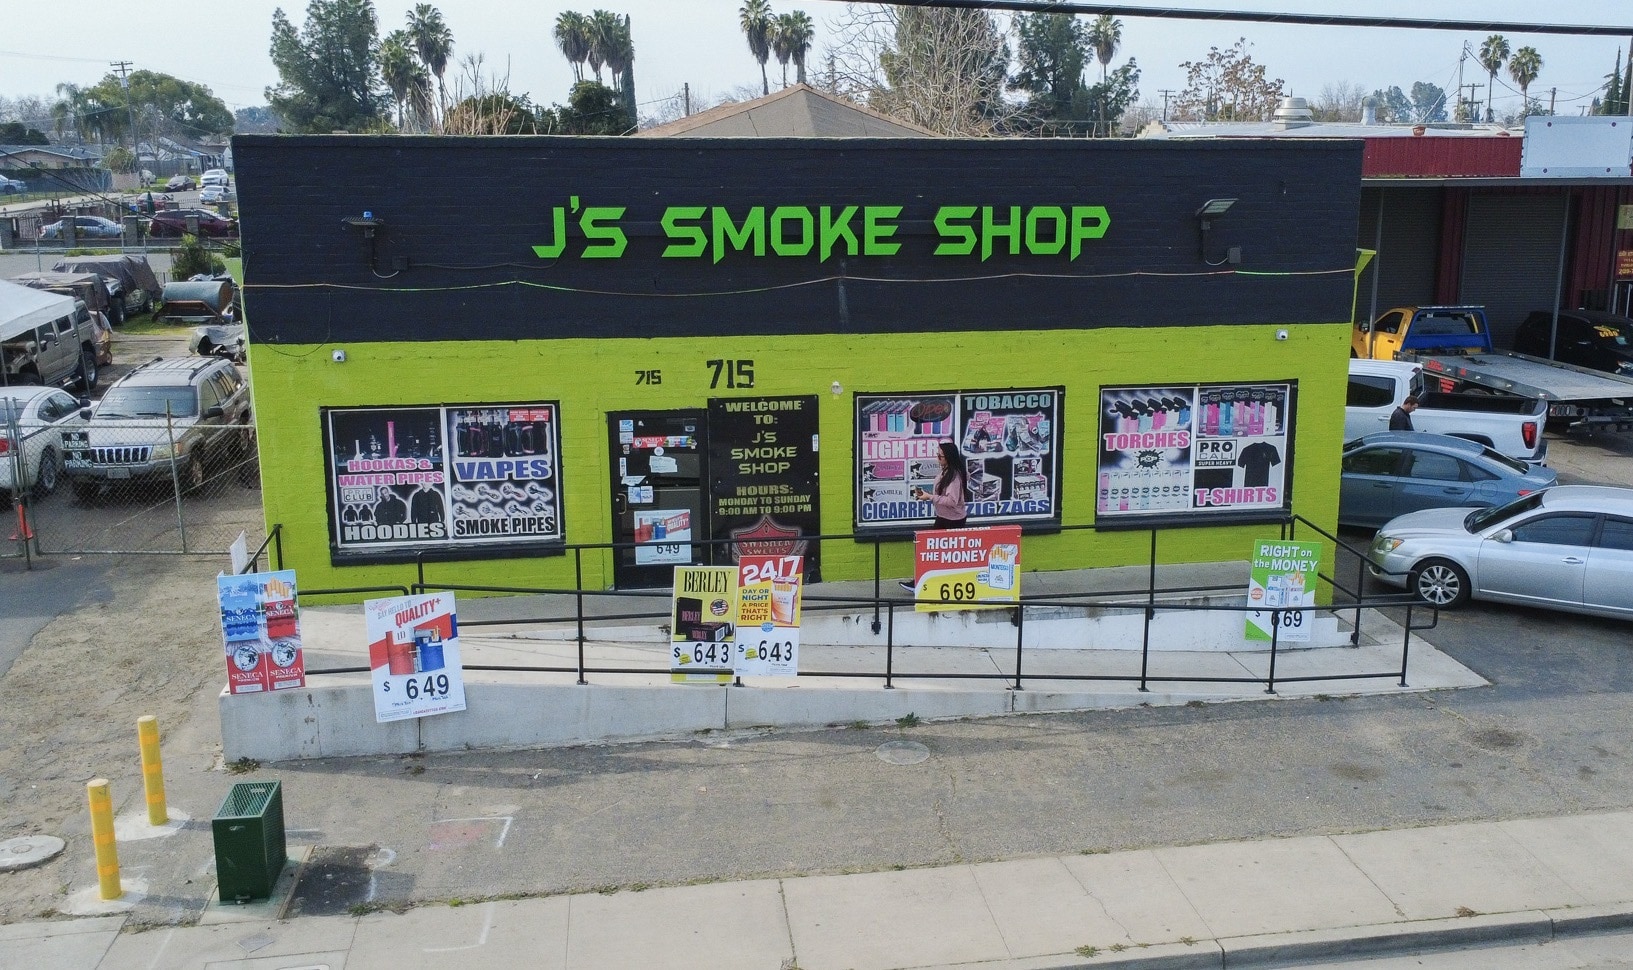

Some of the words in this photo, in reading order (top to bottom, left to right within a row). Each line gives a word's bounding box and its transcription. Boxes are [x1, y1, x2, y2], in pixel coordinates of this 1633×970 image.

[532, 195, 627, 258] J'S
[660, 205, 903, 265] SMOKE
[933, 205, 1111, 263] SHOP
[635, 369, 662, 385] 715
[706, 359, 755, 390] 715
[725, 400, 802, 412] WELCOME
[964, 394, 1051, 410] TOBACCO
[753, 414, 778, 425] TO:
[752, 431, 777, 444] J'S
[1105, 432, 1189, 450] TORCHES
[731, 446, 798, 460] SMOKE
[863, 439, 942, 460] LIGHTER
[1200, 442, 1233, 452] PRO
[72, 452, 82, 460] NO
[348, 458, 416, 472] HOOKAS
[418, 459, 432, 470] &
[455, 459, 549, 480] VAPES
[738, 462, 791, 475] SHOP
[338, 474, 395, 487] WATER
[396, 471, 444, 485] PIPES
[736, 484, 794, 496] HOURS:
[1195, 487, 1277, 506] T-SHIRTS
[718, 497, 758, 506] MONDAY
[760, 496, 772, 505] TO
[774, 495, 811, 504] SUNDAY
[718, 507, 740, 516] 9:00
[742, 506, 758, 515] AM
[760, 506, 772, 514] TO
[774, 505, 796, 514] 9:00
[797, 504, 812, 513] PM
[863, 502, 937, 520] CIGARRET
[344, 523, 445, 541] HOODIES
[455, 518, 509, 536] SMOKE
[512, 516, 554, 533] PIPES
[926, 536, 967, 550] RIGHT
[968, 538, 982, 548] ON
[920, 552, 939, 562] THE
[941, 550, 987, 564] MONEY
[1260, 544, 1300, 557] RIGHT
[1300, 549, 1312, 557] on
[1254, 558, 1270, 568] the
[1270, 559, 1318, 572] MONEY
[684, 571, 731, 592] BERLEY
[266, 608, 294, 617] SENECA
[674, 646, 680, 658] $
[270, 668, 302, 676] SENECA
[384, 681, 390, 692] $
